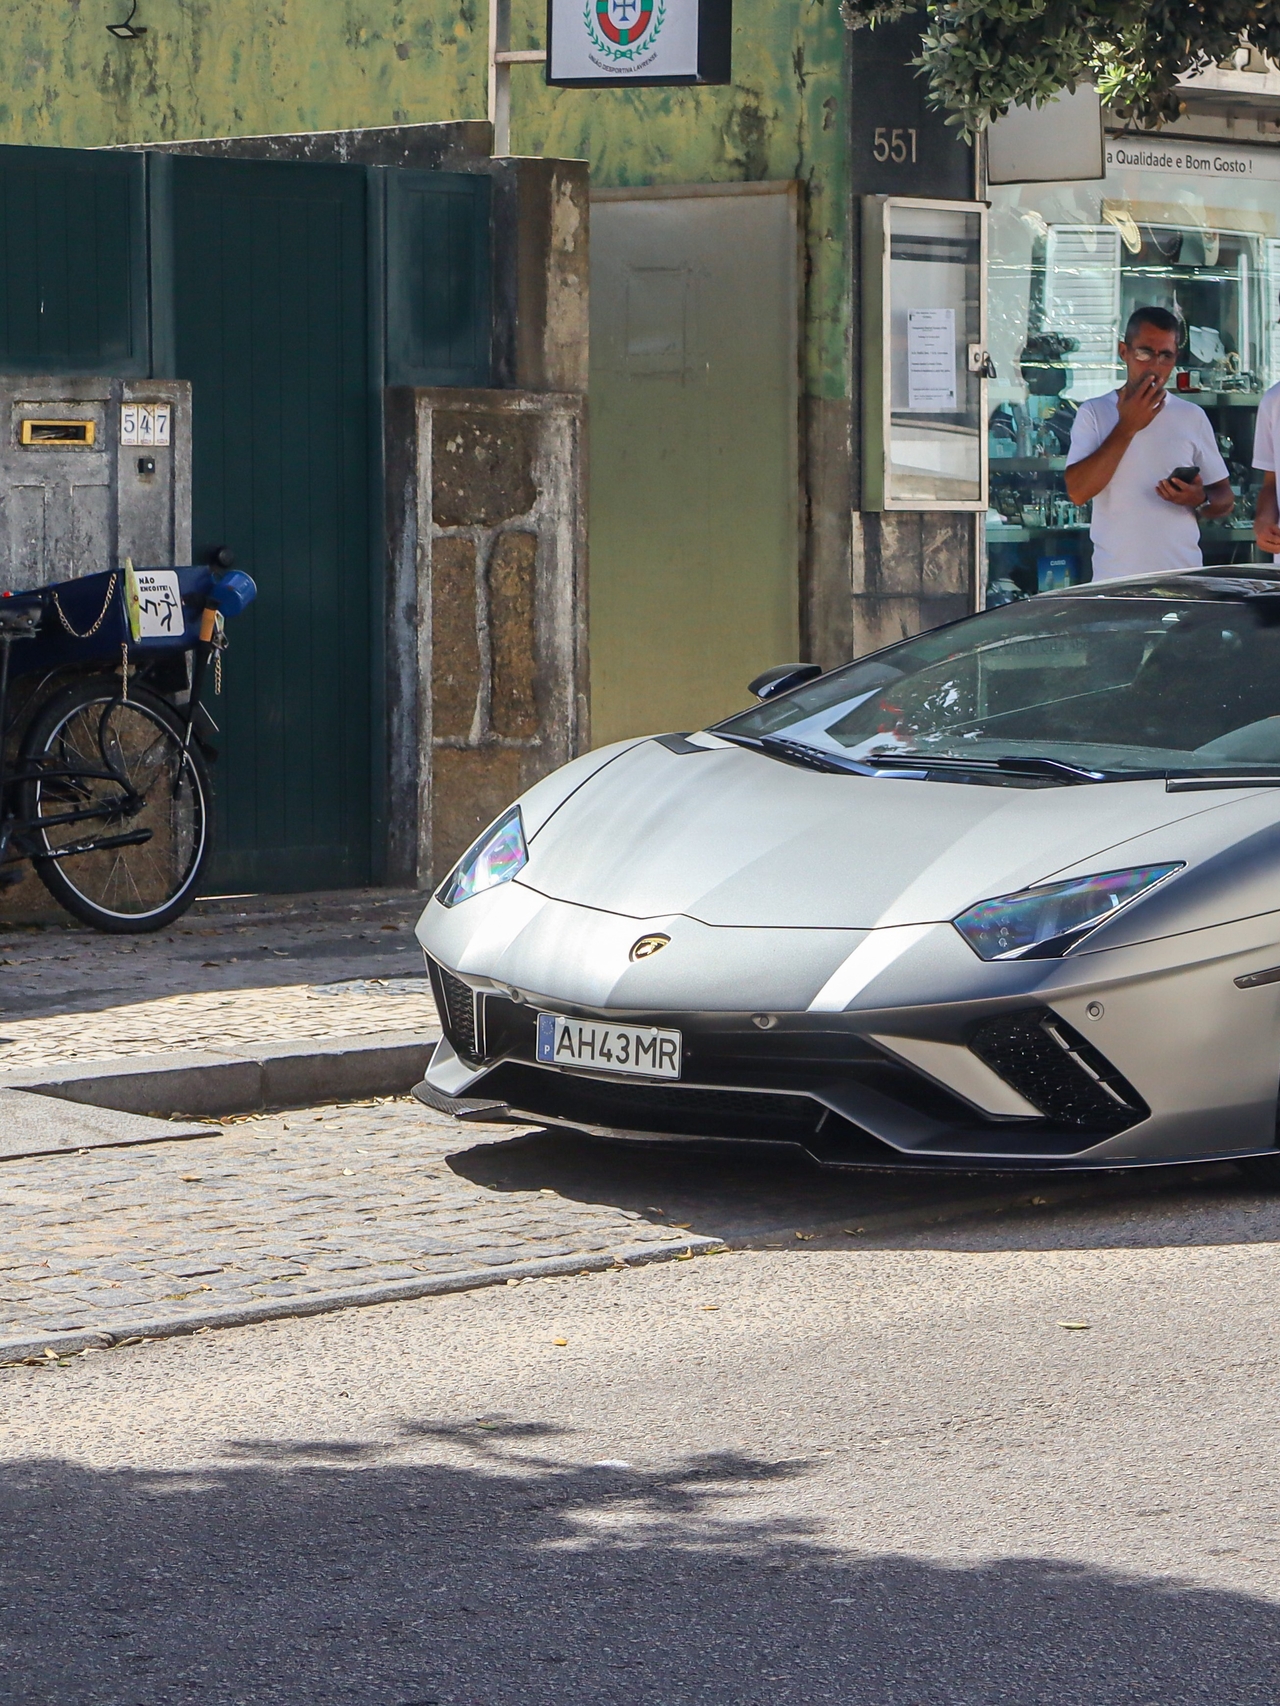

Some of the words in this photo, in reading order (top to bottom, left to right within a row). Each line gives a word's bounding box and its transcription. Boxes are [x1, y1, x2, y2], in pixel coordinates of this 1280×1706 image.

[602, 63, 633, 73] DESPORTIVA
[633, 51, 659, 72] LAVRENSE
[873, 127, 917, 163] 551
[1116, 149, 1173, 168] Qualidade
[1176, 157, 1183, 168] e
[1186, 154, 1211, 170] Bom
[1213, 157, 1246, 173] Gosto
[123, 413, 168, 435] 547
[544, 1044, 551, 1055] P
